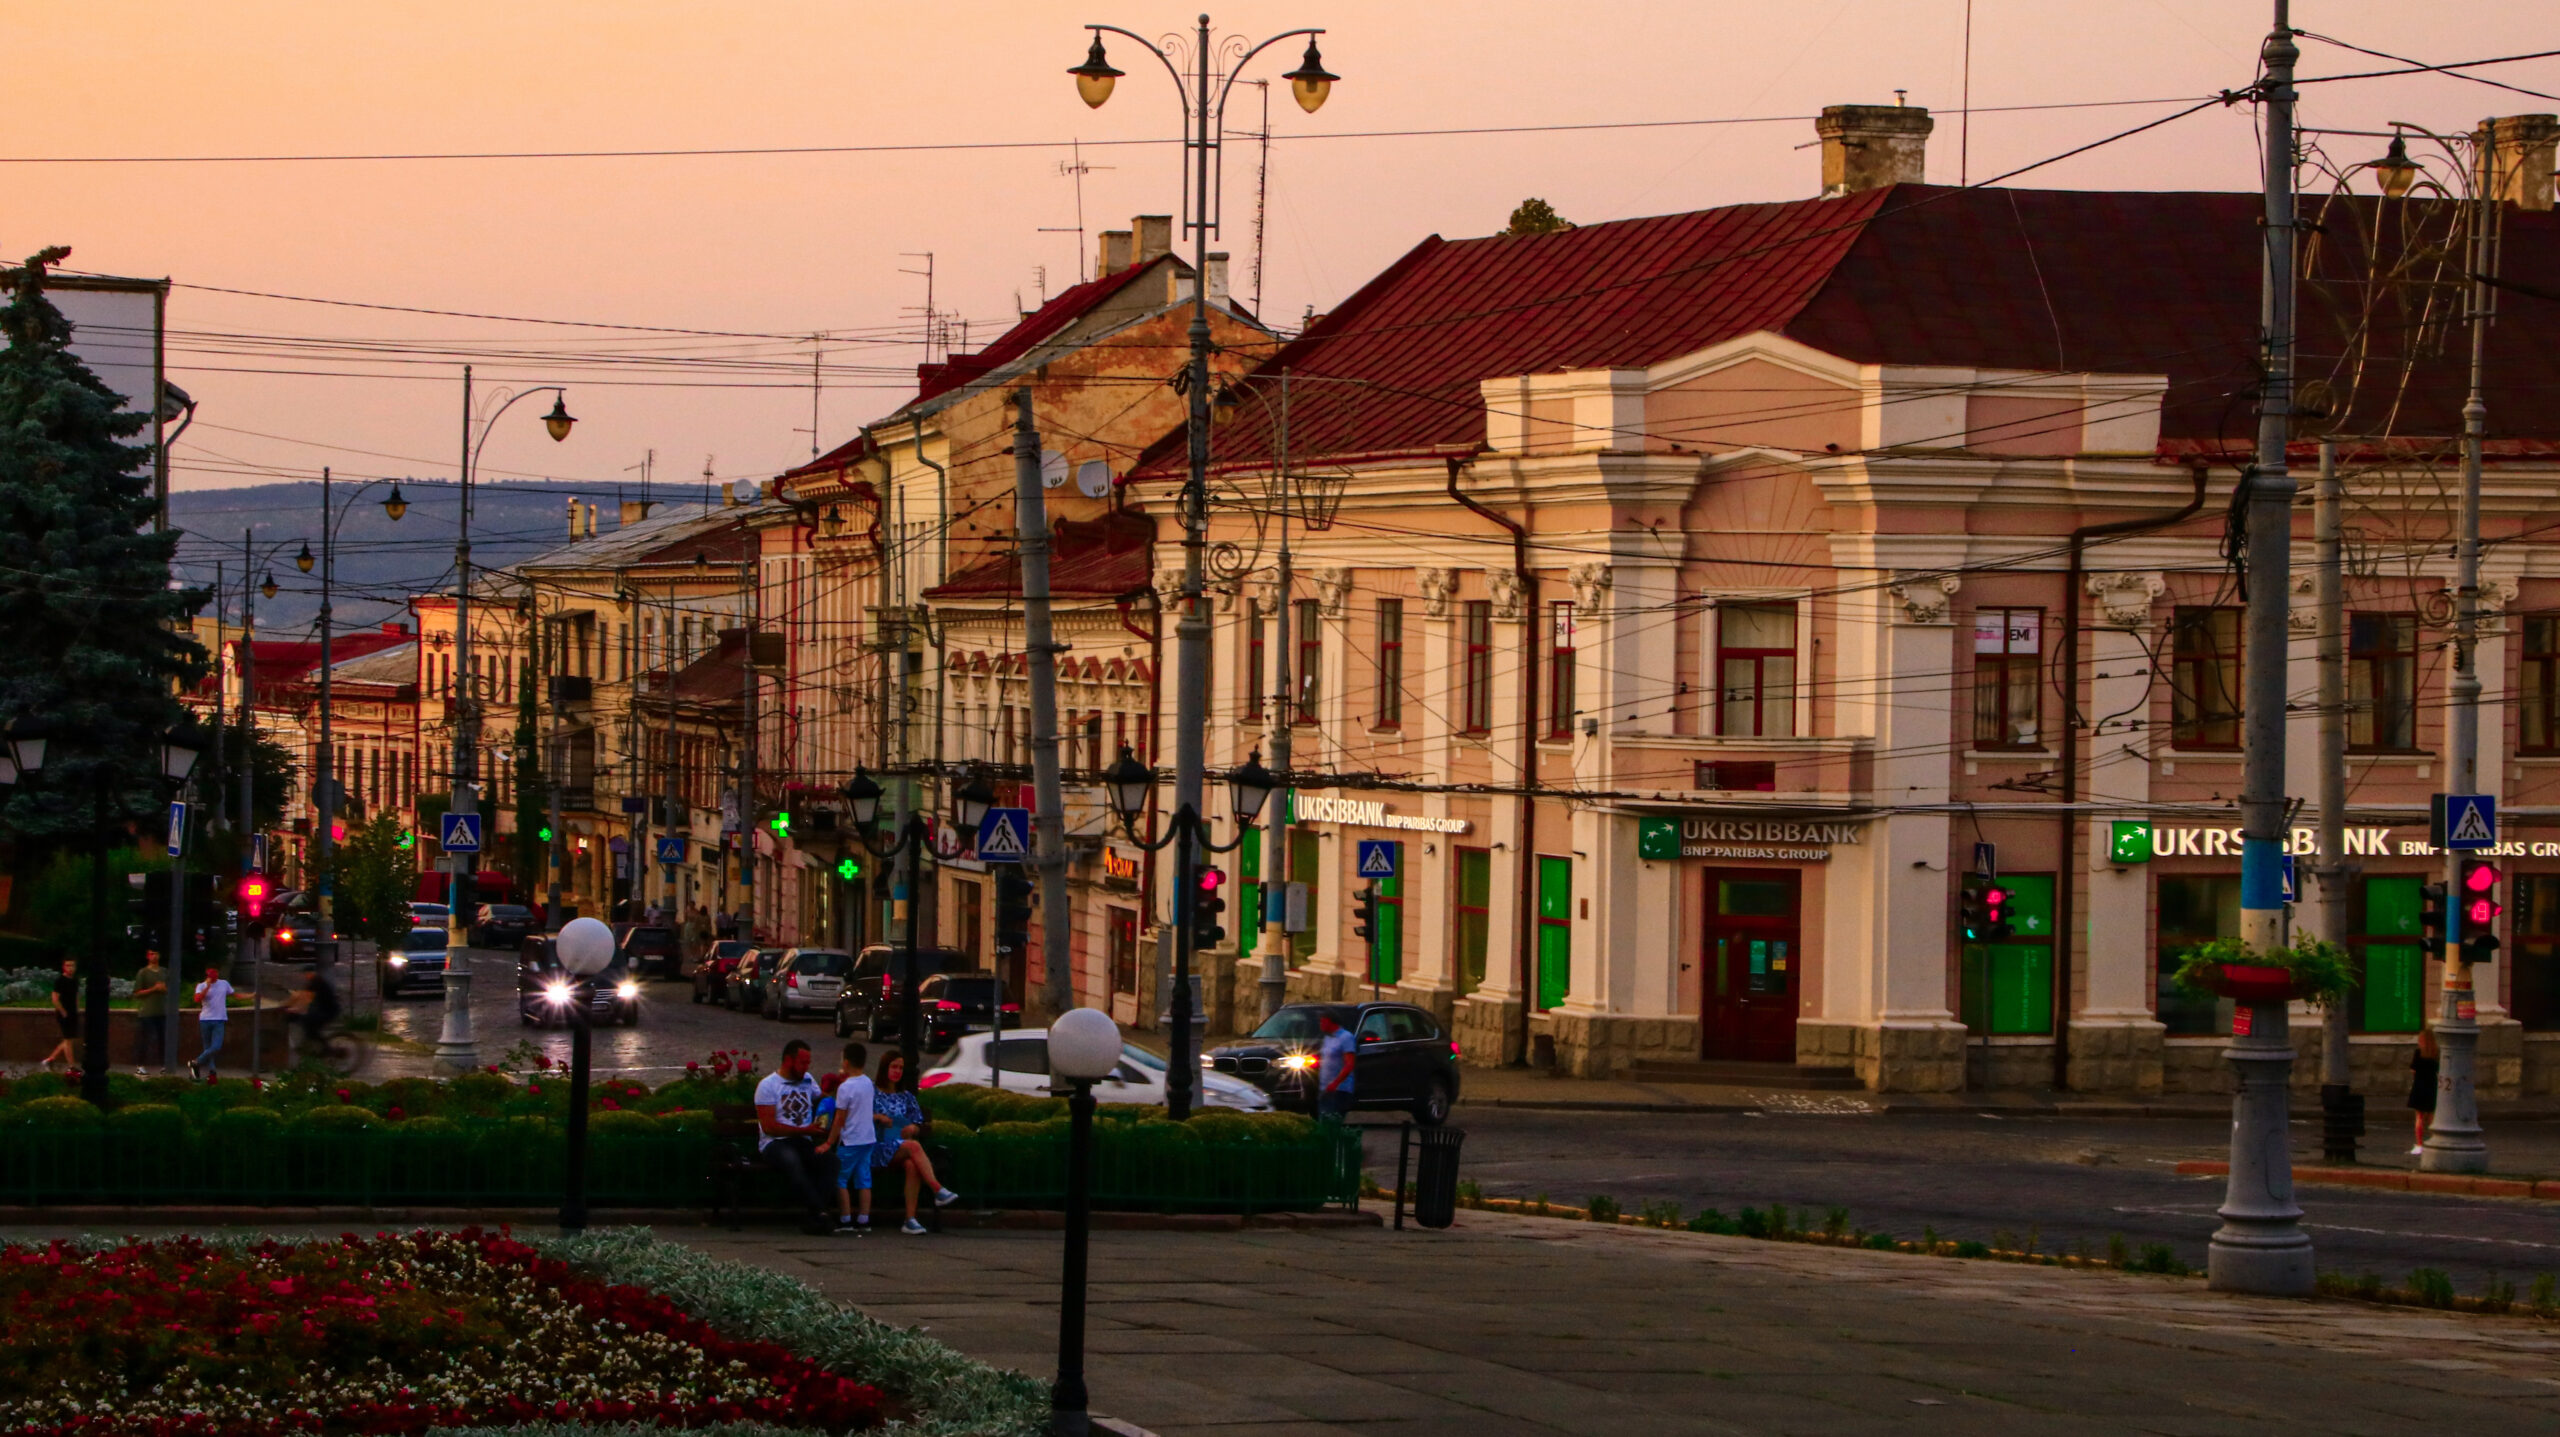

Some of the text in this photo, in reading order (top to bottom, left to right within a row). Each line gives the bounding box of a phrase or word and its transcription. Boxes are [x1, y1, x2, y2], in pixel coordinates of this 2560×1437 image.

[1299, 795, 1465, 833] UKRSIBBANK BNP PARIBAS GROUP
[1682, 820, 1858, 844] UKRSIBBANK
[2152, 827, 2391, 857] UKRSBNK
[2531, 841, 2560, 857] GR
[1682, 845, 1829, 860] BNP PARIBAS GROUP
[2474, 902, 2488, 921] 19
